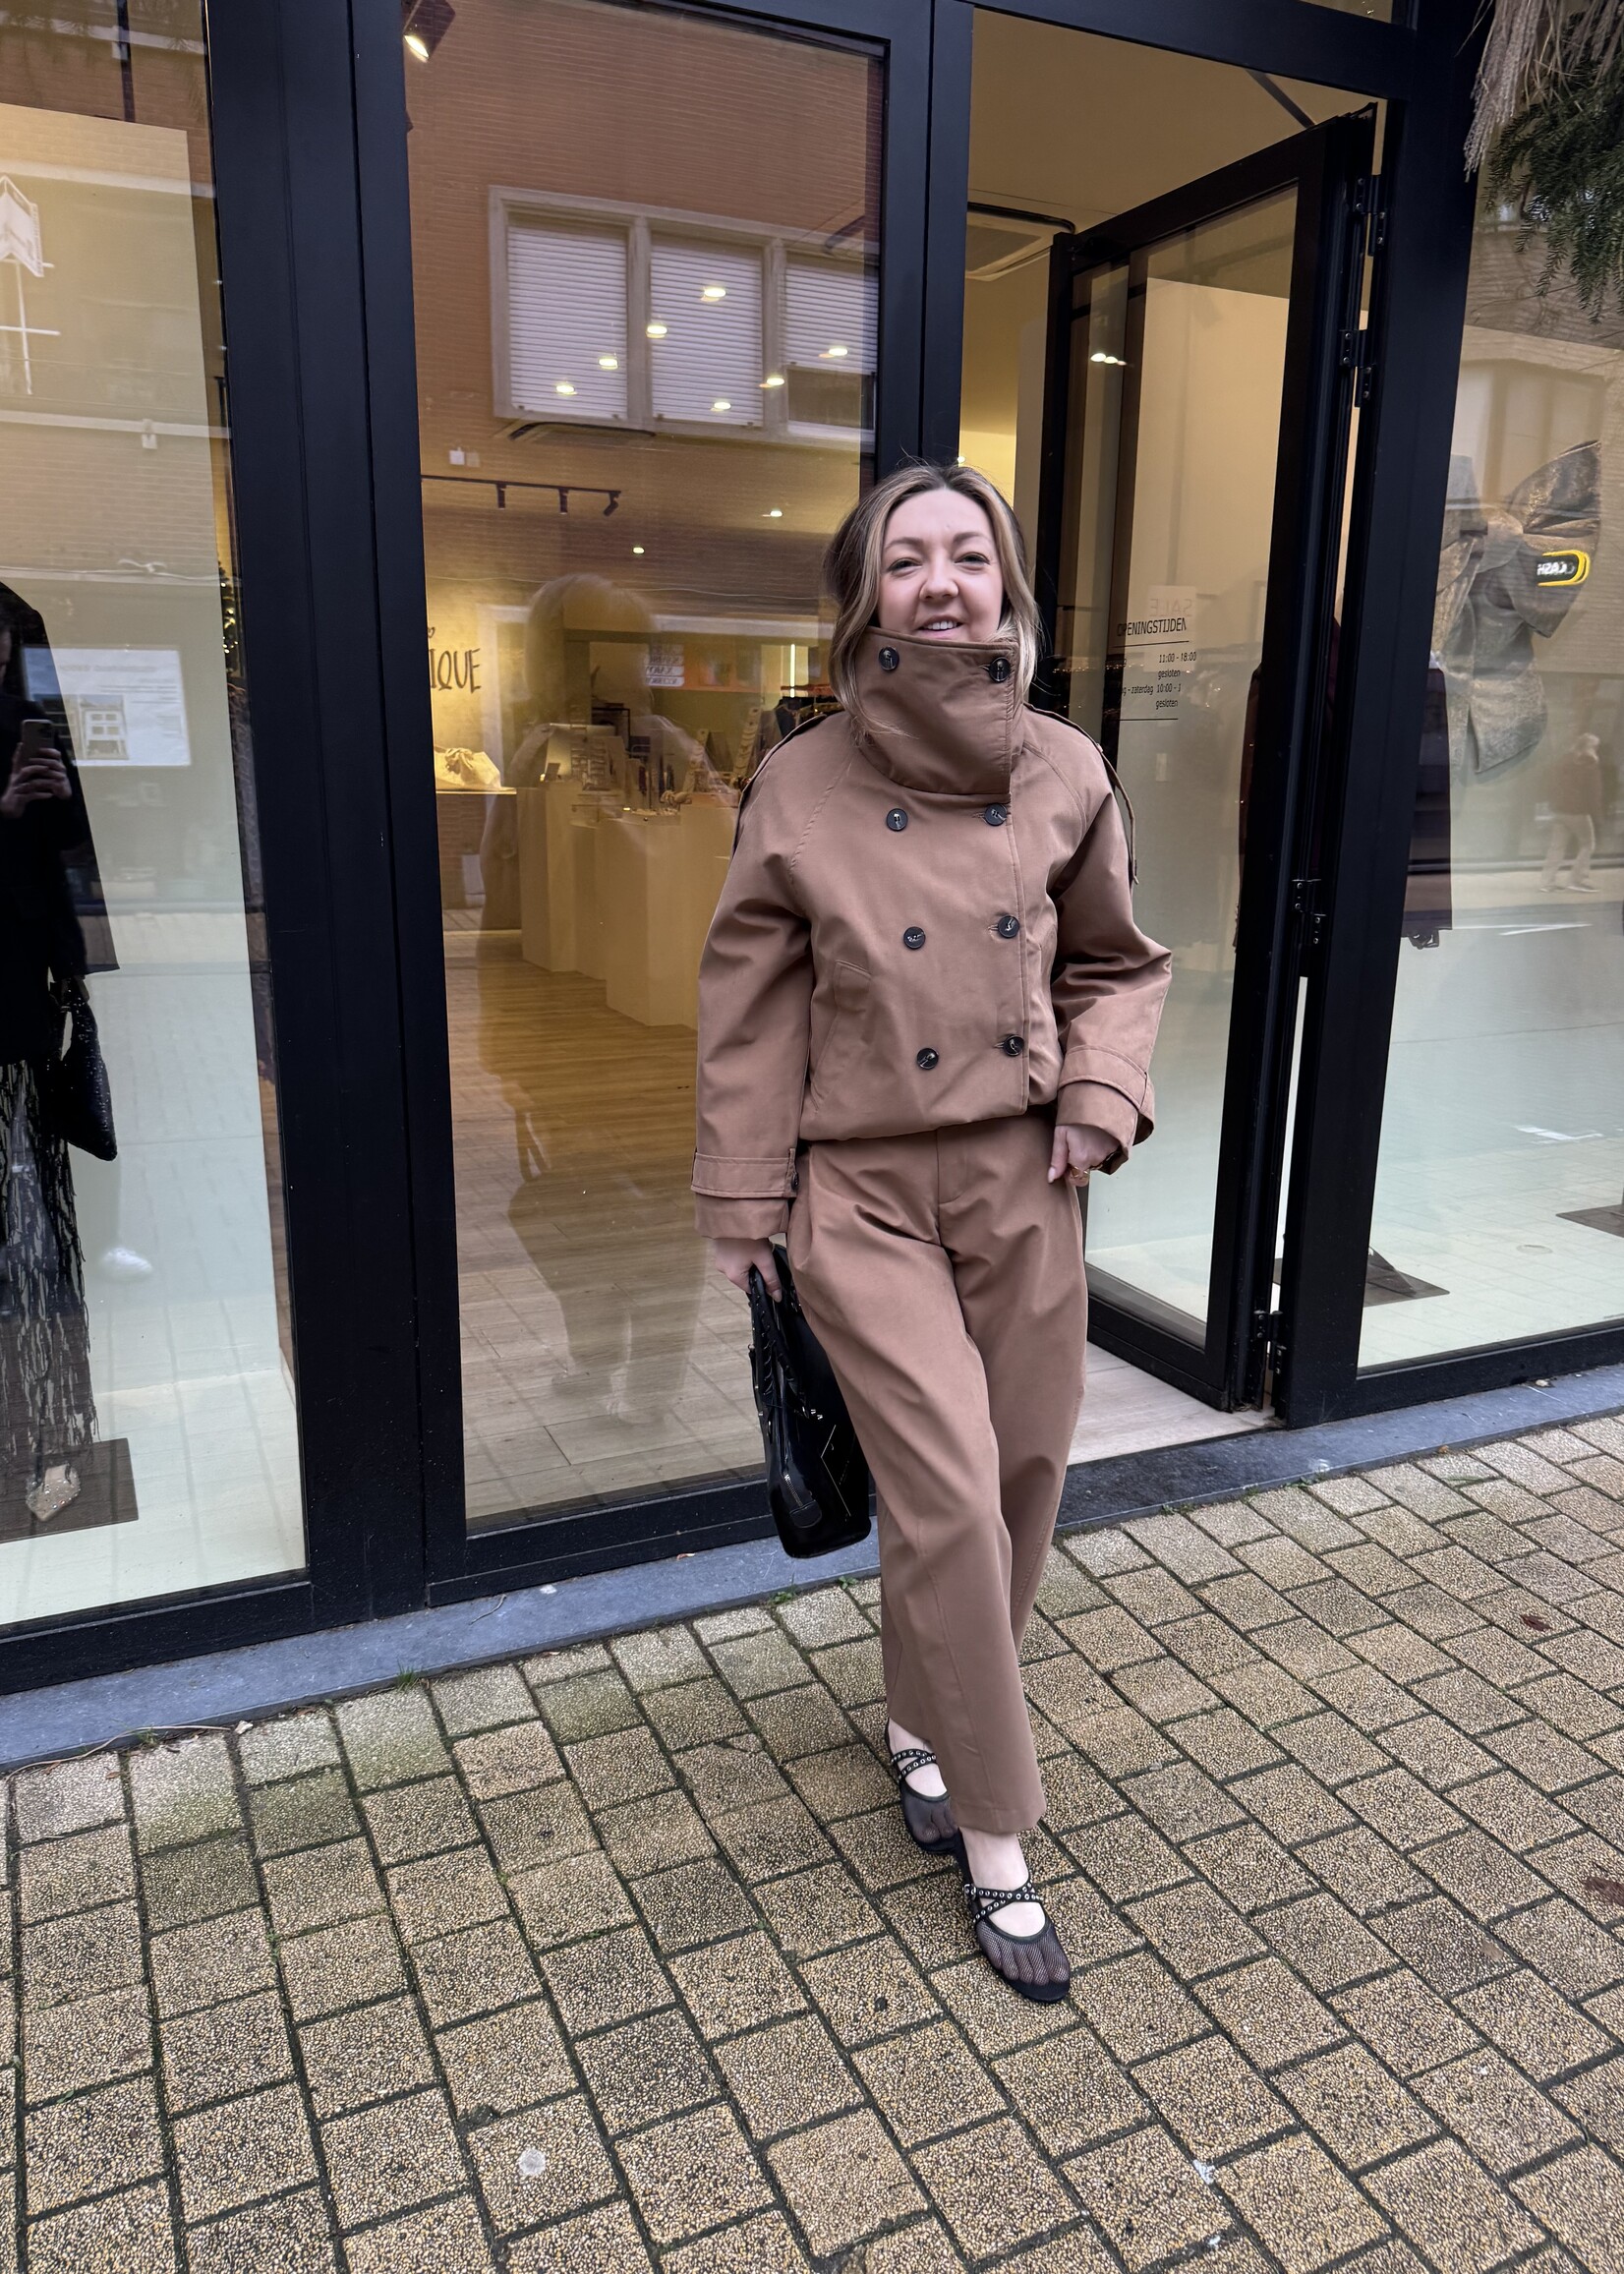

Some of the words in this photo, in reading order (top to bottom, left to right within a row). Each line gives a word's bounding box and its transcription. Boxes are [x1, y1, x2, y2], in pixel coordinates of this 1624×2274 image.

[1117, 617, 1187, 637] OPENINGSTIJDEN
[1159, 654, 1175, 663] 11:00
[1158, 670, 1180, 680] gesloten
[1131, 684, 1154, 696] zaterdag
[1156, 682, 1172, 693] 10:00
[1156, 699, 1178, 710] gesloten
